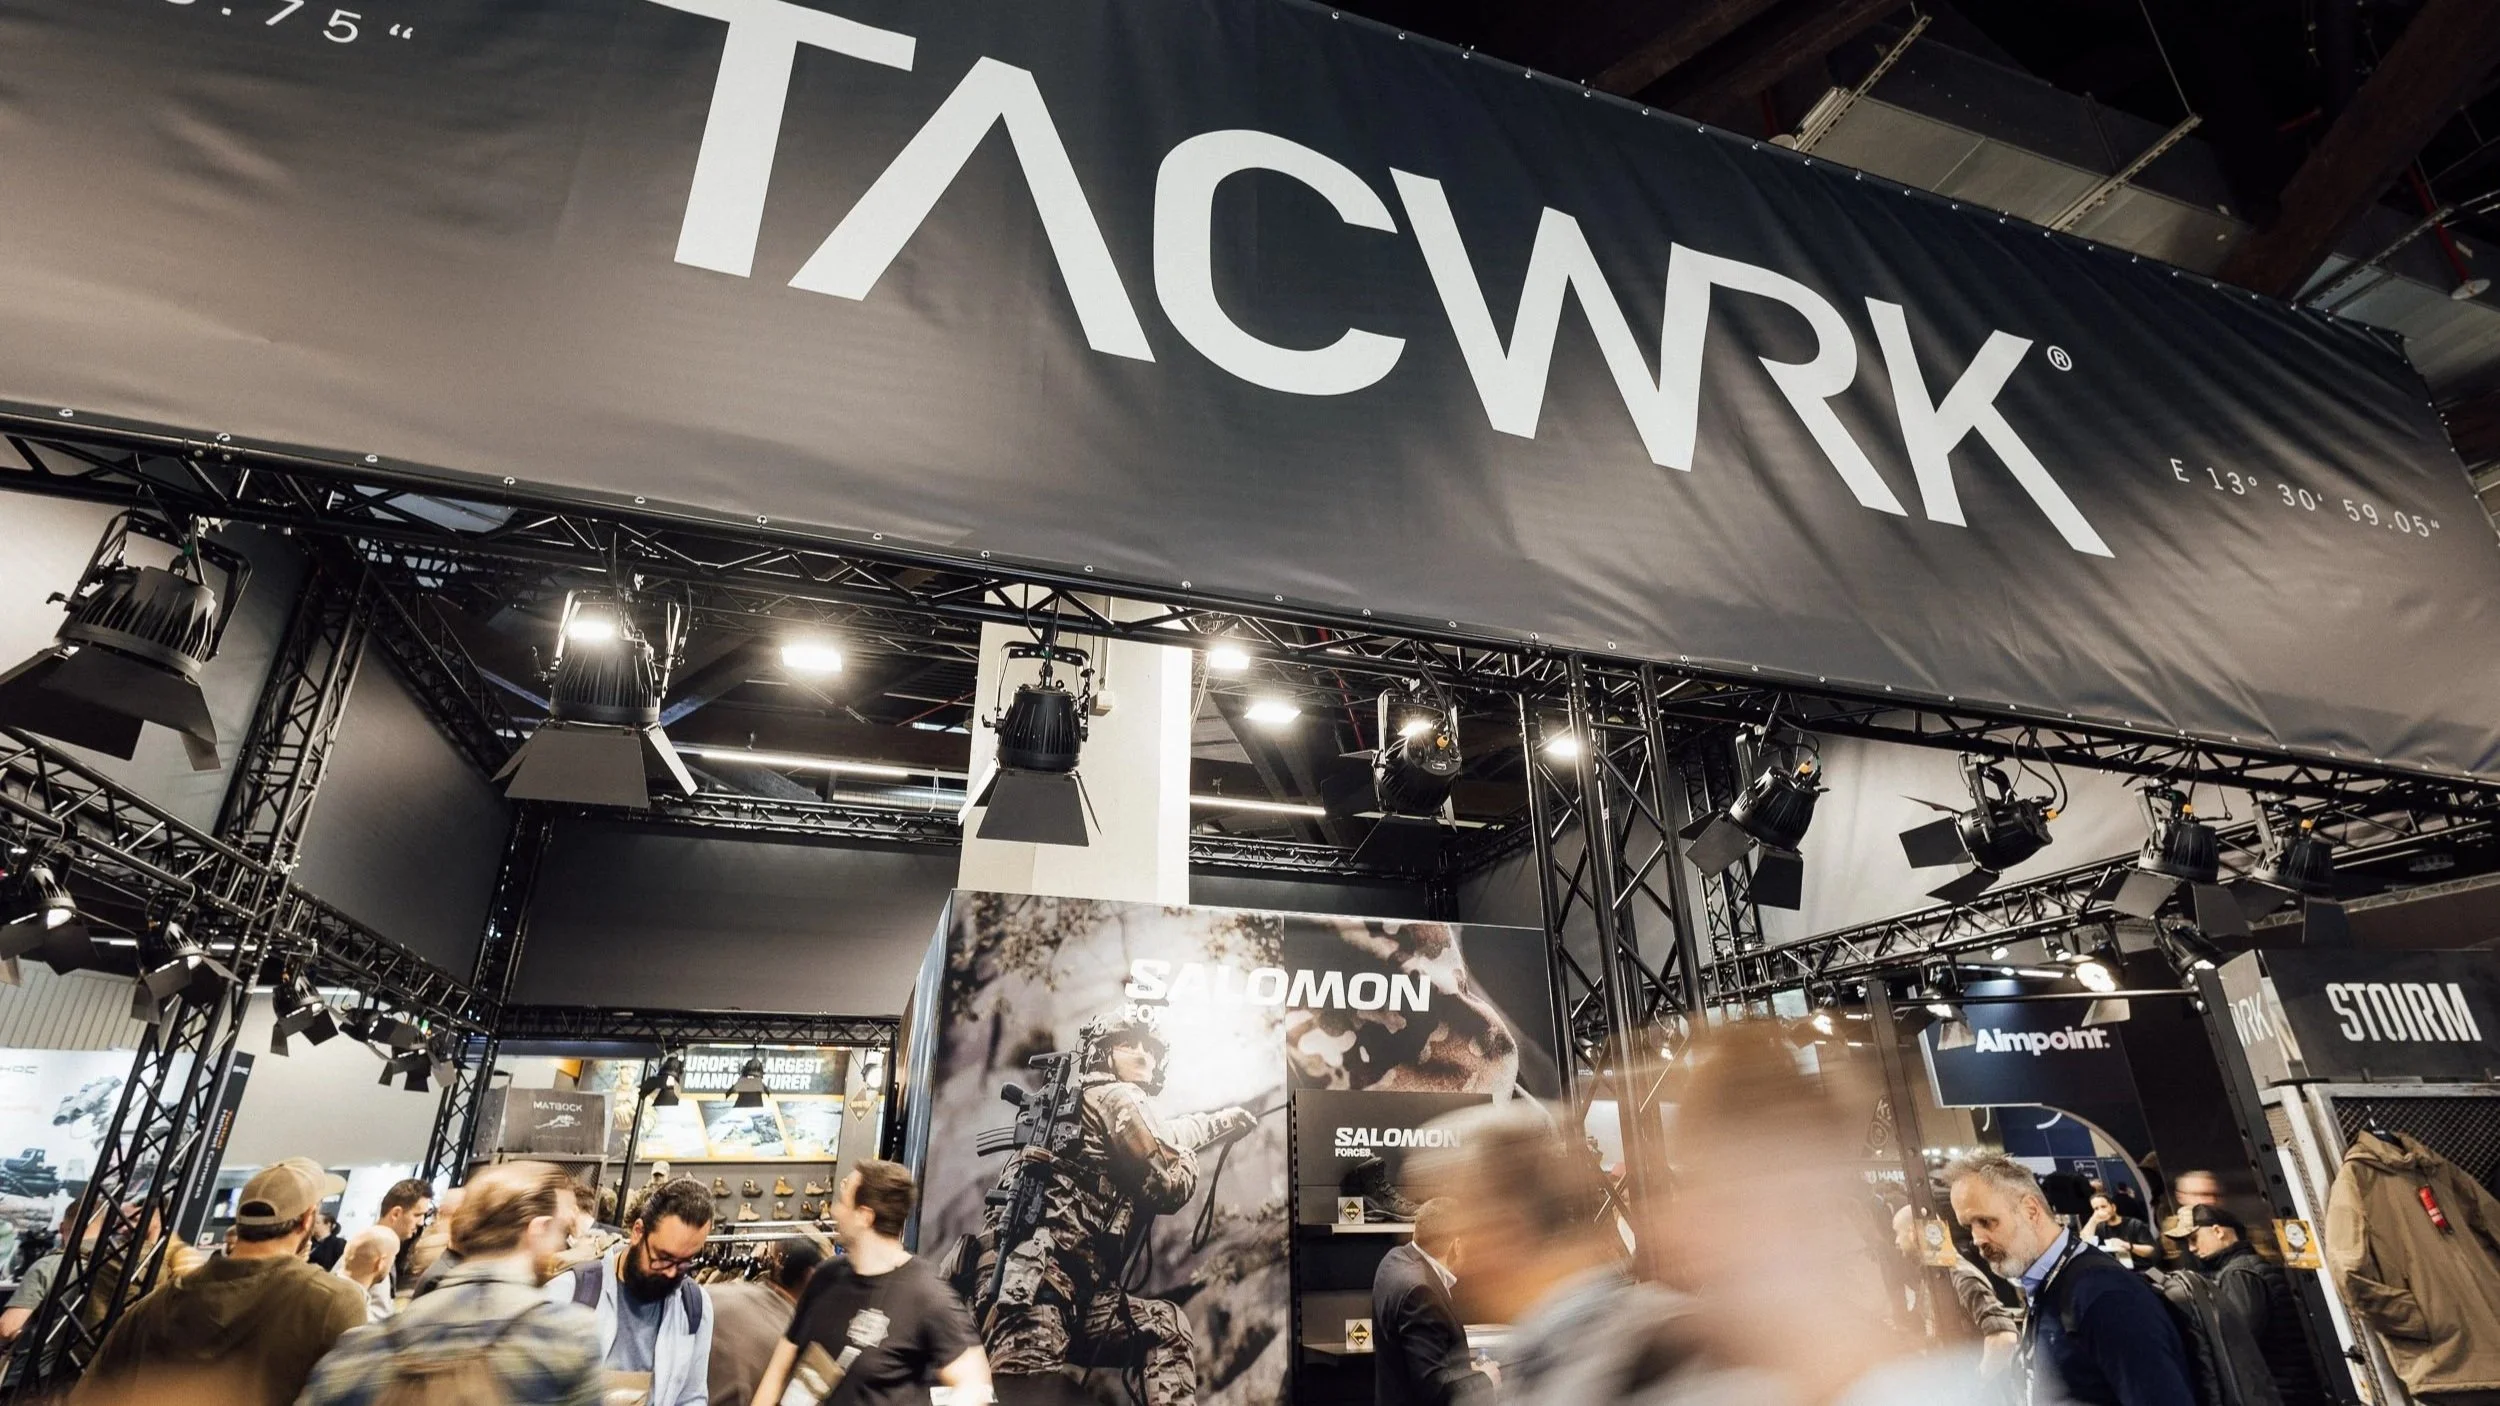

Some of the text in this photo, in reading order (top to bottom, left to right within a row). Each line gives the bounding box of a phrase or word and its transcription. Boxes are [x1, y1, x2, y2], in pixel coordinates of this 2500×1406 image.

[165, 0, 414, 43] .75“
[2170, 458, 2190, 483] E
[2207, 467, 2258, 495] 13°
[1124, 958, 1431, 1012] SALOMON
[2325, 983, 2483, 1041] STOIRM
[533, 1101, 583, 1112] MATBOCK
[1334, 1127, 1461, 1148] SALOMON
[194, 1150, 216, 1199] Cameras
